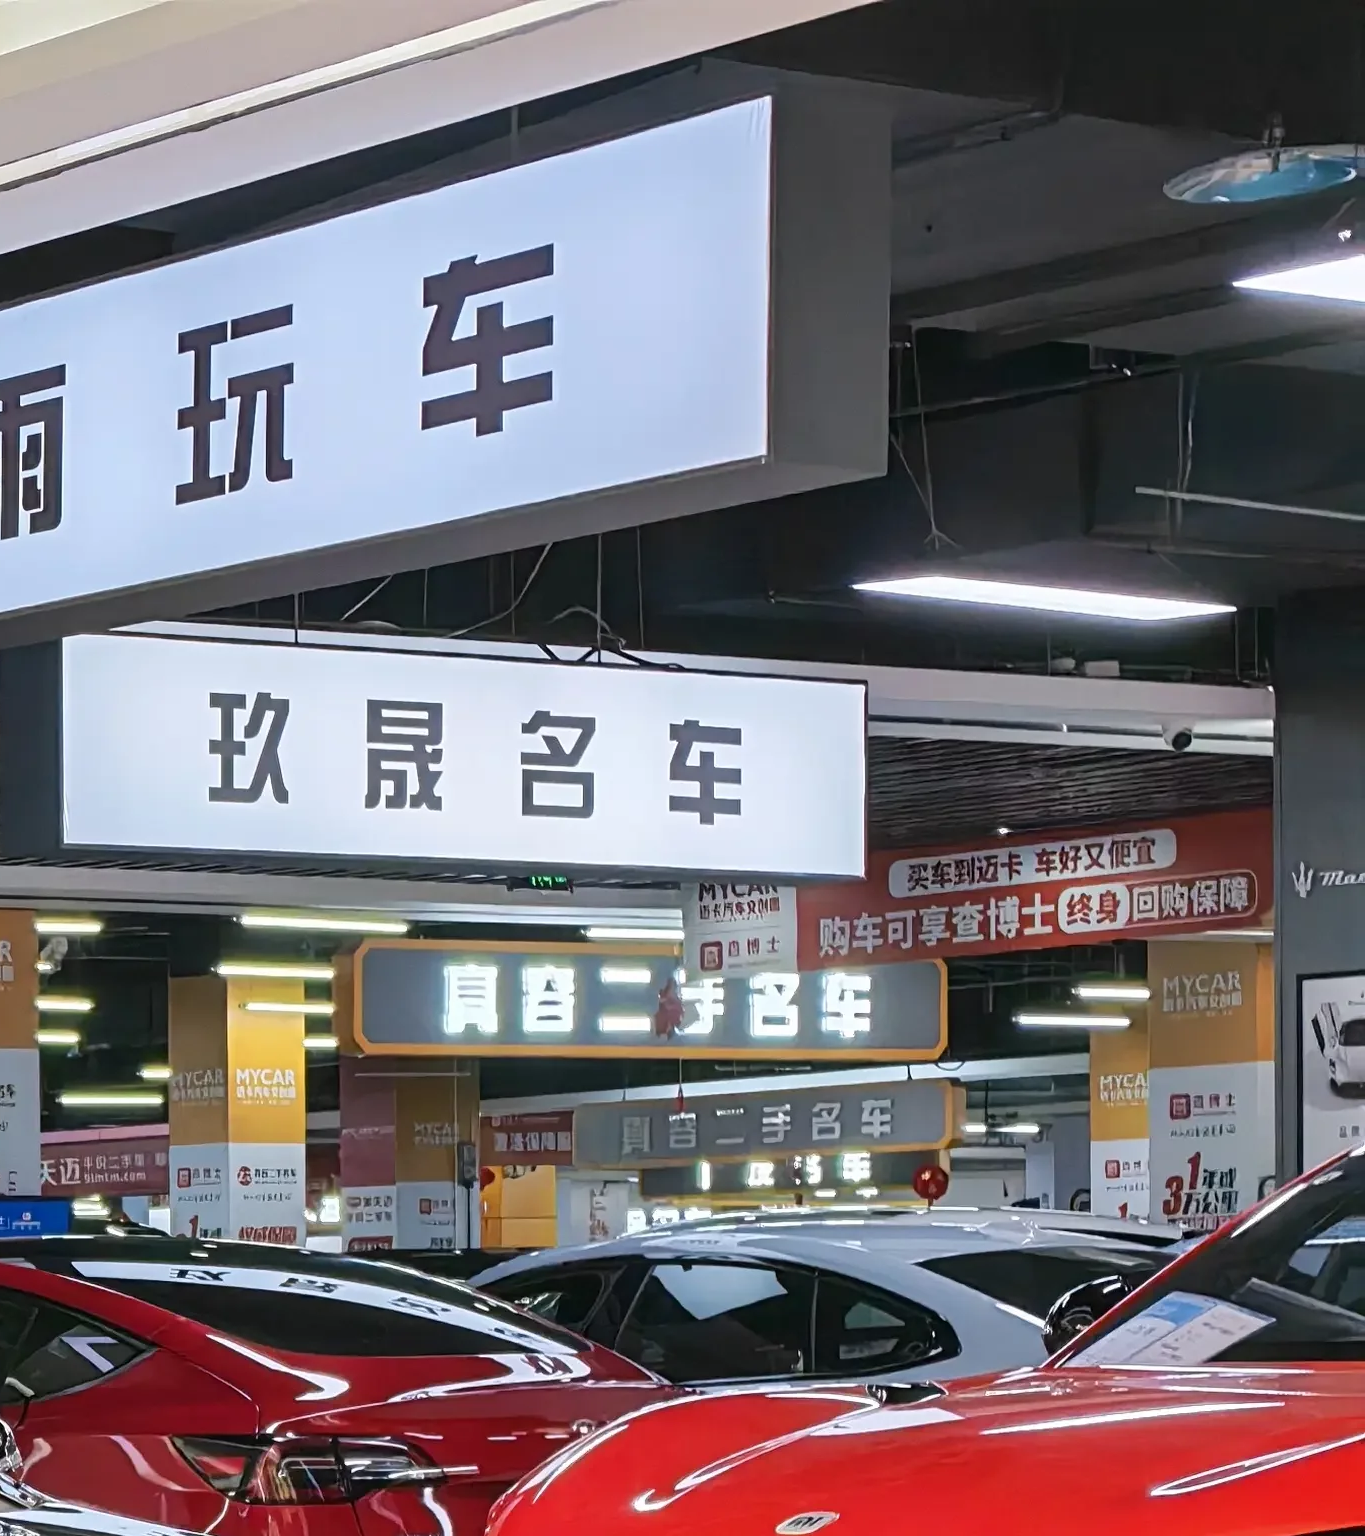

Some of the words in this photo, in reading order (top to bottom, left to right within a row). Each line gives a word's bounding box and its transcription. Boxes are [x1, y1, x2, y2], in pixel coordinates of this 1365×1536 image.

[208, 690, 743, 826] 玖晟名车
[907, 850, 1024, 892] 买车到迈卡
[1034, 836, 1157, 877] 车好又便宜
[819, 876, 1249, 958] 购车可享查博士终身回购保障
[1162, 971, 1242, 996] MYCAR
[236, 1068, 295, 1086] MYCAR
[1099, 1073, 1149, 1090] MYCA
